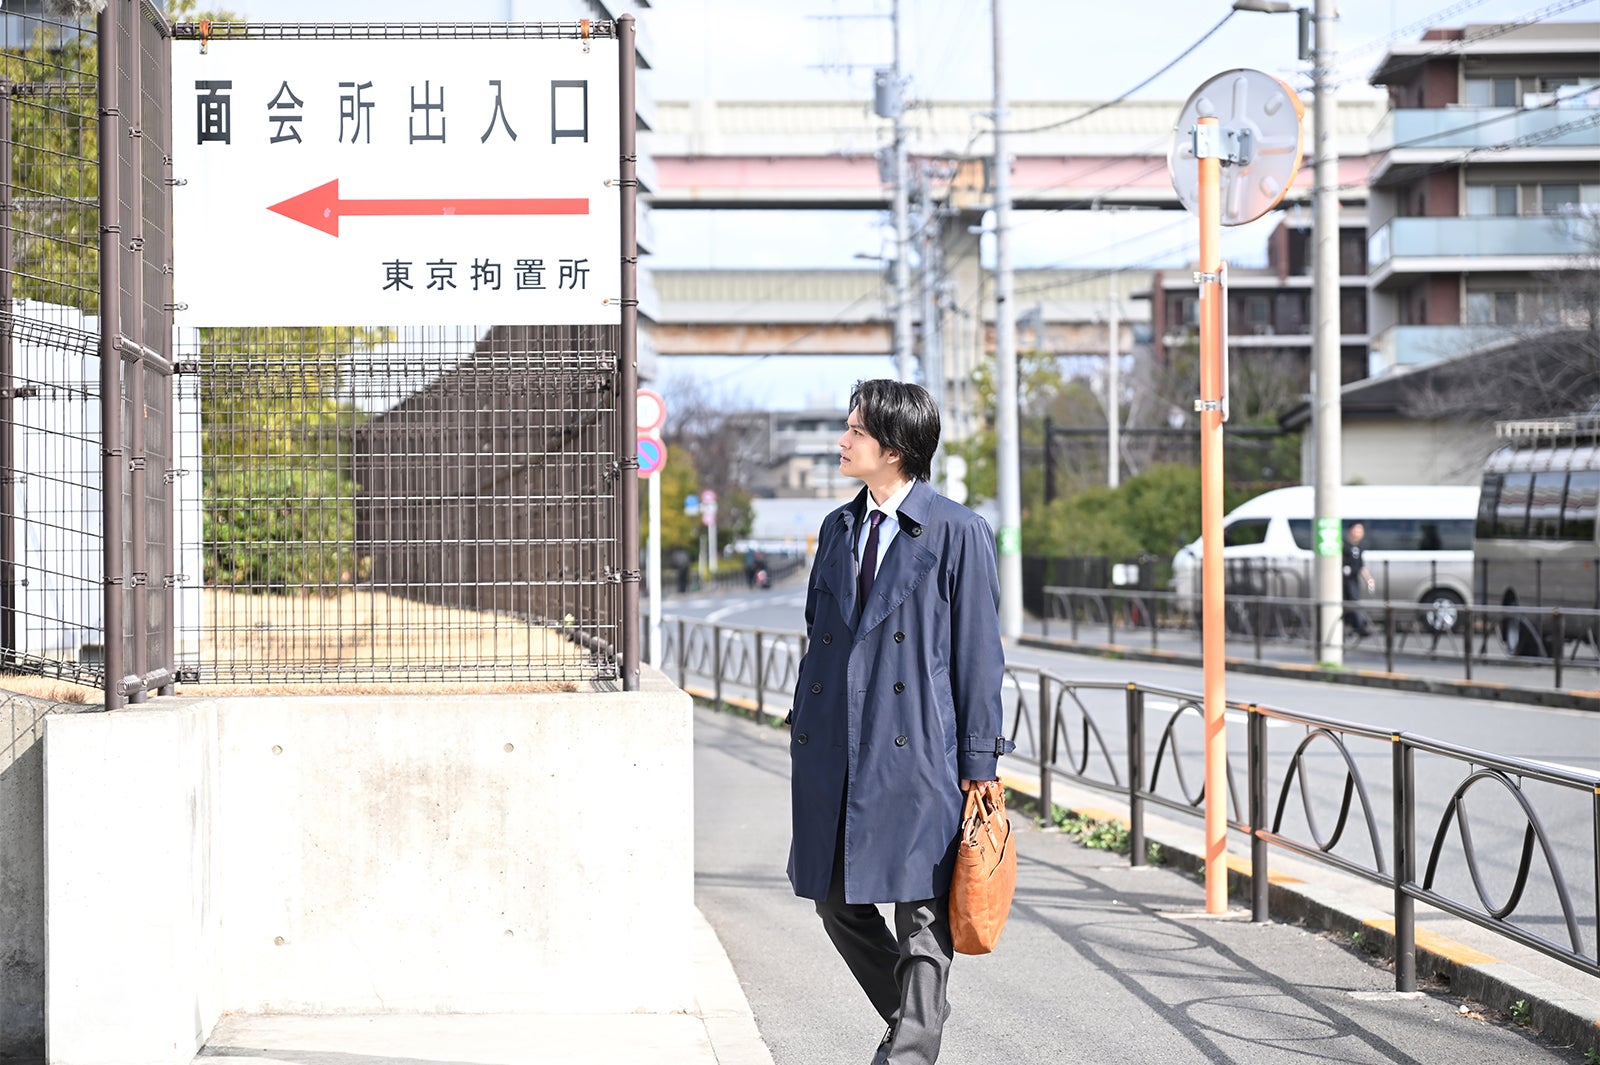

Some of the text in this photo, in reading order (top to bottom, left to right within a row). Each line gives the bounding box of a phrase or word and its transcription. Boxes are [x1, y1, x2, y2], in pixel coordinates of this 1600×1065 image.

[195, 80, 588, 145] 面会所出入口
[382, 258, 590, 292] 東京拘置所
